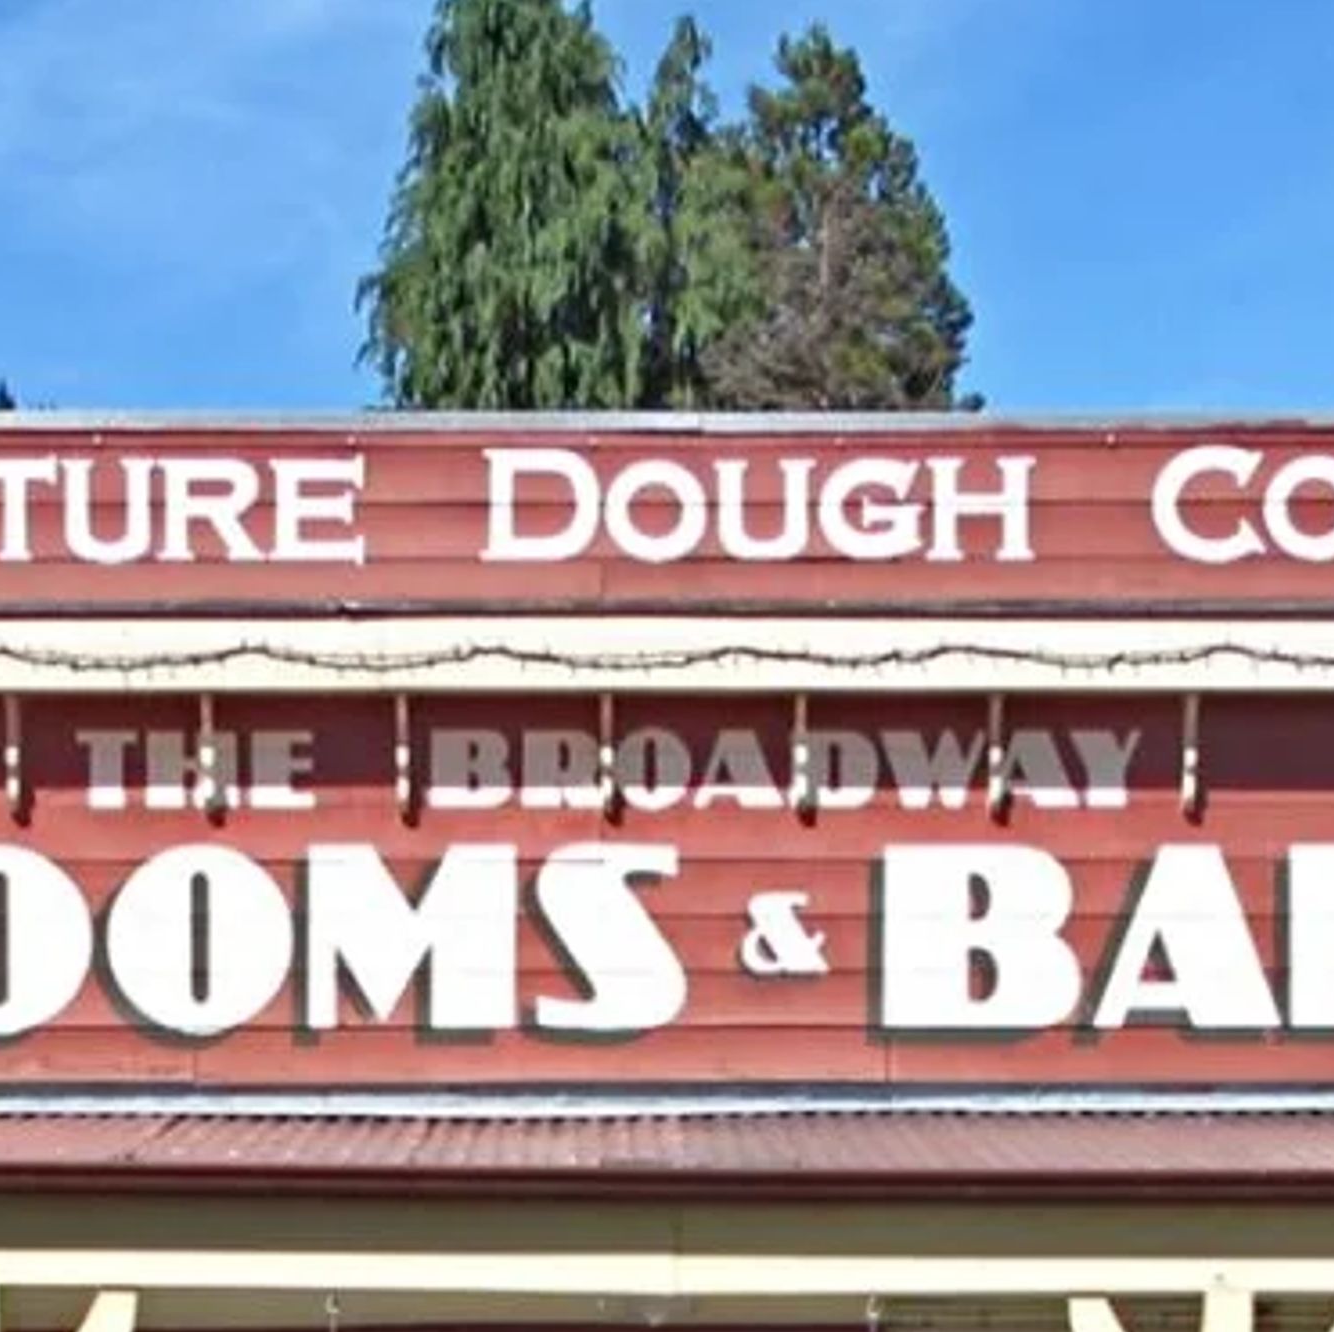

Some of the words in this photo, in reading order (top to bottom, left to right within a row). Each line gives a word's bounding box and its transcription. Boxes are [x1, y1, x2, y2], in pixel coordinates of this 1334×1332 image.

[478, 448, 1036, 564] DOUGH
[75, 728, 317, 810] THE
[426, 726, 1140, 810] BROADWAY
[739, 890, 829, 975] &
